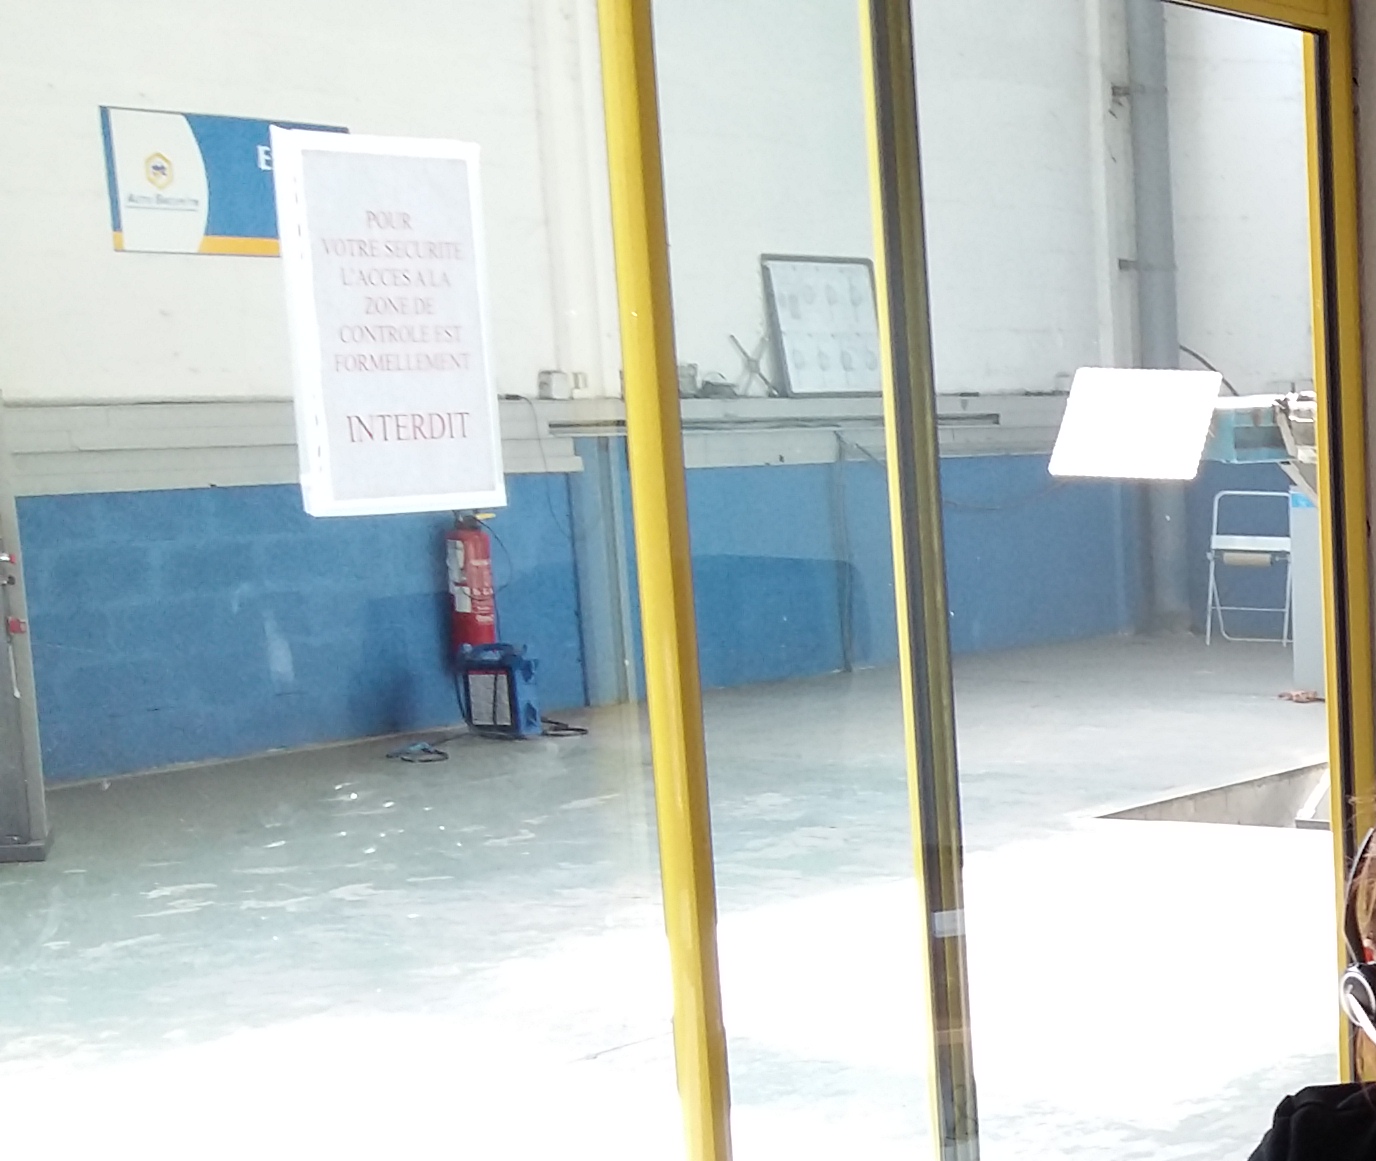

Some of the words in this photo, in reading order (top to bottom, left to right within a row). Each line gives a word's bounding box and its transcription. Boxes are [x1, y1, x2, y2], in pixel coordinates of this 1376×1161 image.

[366, 210, 412, 230] POUR
[321, 238, 378, 258] VOTRE
[384, 239, 464, 260] SECURITE
[340, 267, 411, 287] L'ACCES
[415, 269, 426, 287] A
[429, 269, 452, 287] LA
[365, 297, 410, 315] ZONE
[414, 297, 435, 315] DE
[339, 325, 431, 344] CONTROLE
[436, 325, 463, 343] EST
[334, 353, 471, 372] FORMELLEMENT
[346, 412, 470, 443] INTERDIT
